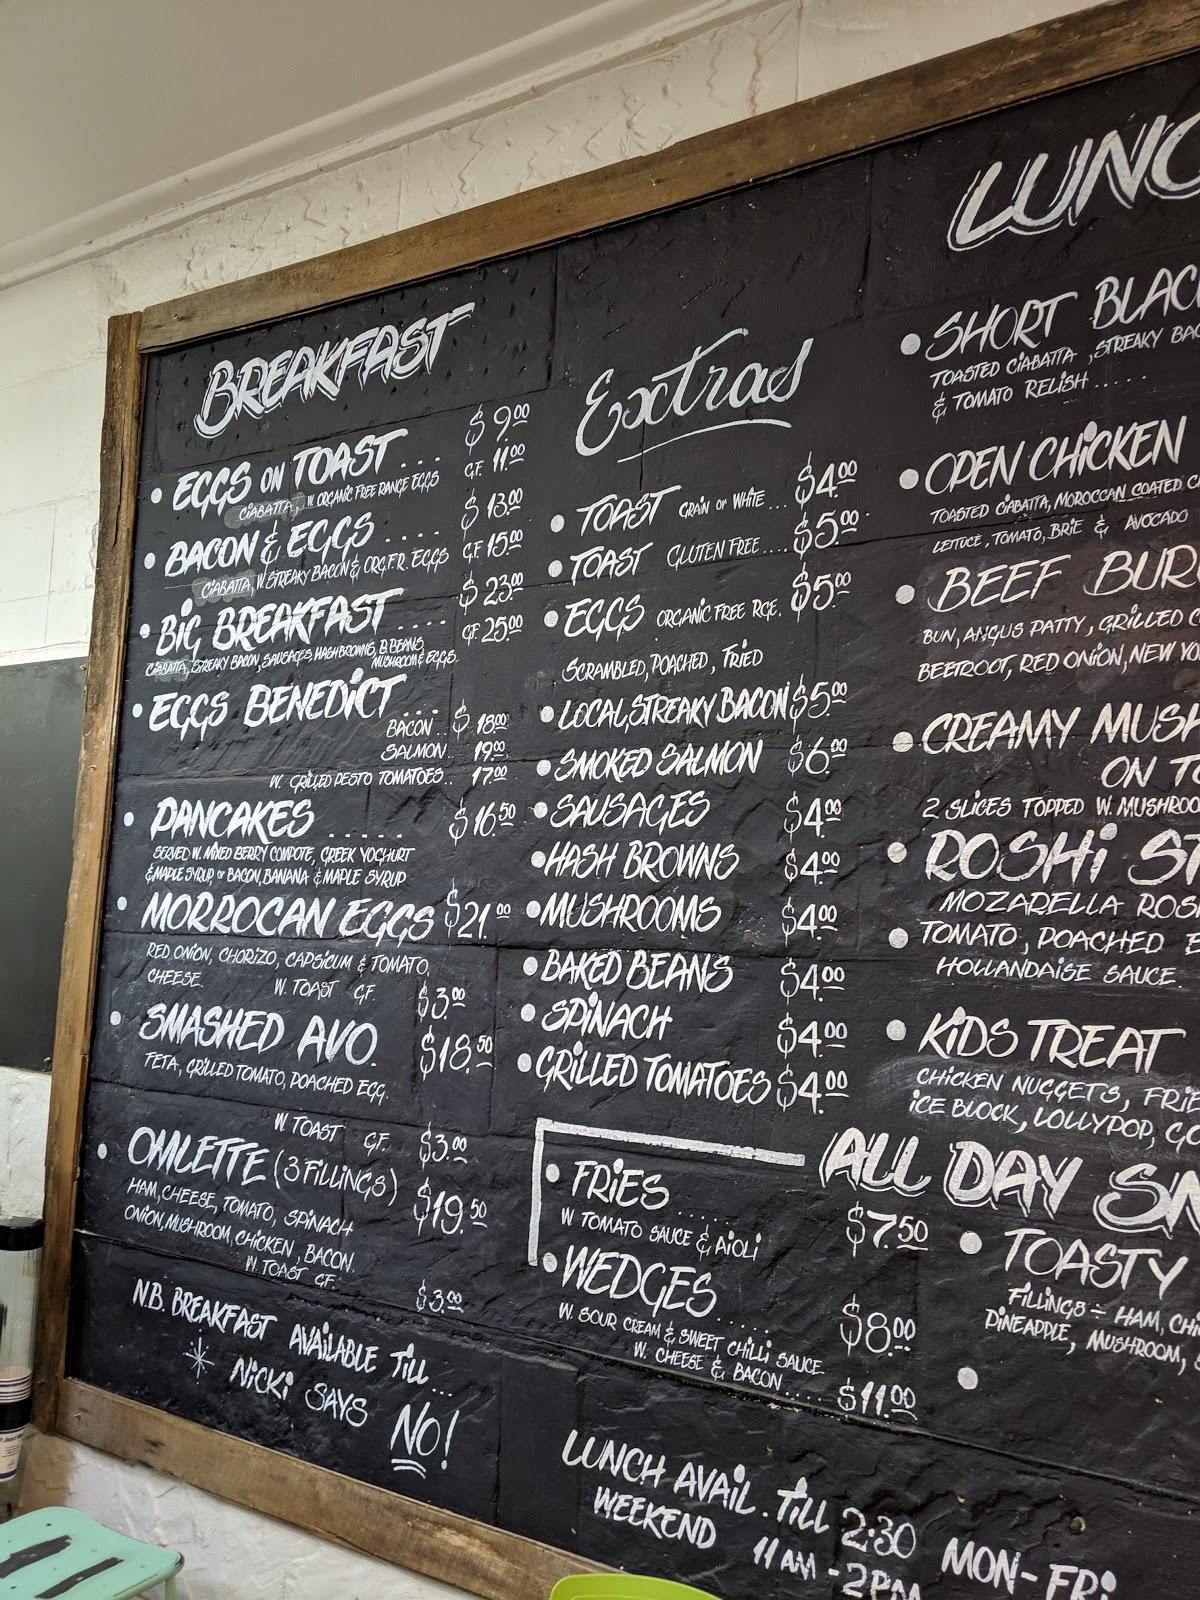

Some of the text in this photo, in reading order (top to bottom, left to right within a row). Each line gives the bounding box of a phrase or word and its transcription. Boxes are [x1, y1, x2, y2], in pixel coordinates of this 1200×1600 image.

[925, 291, 1078, 361] SHORT
[194, 303, 475, 438] BREAKFAST
[575, 328, 814, 456] Extras
[930, 361, 1000, 389] TOASTED
[953, 386, 1014, 411] TOMATO
[172, 428, 408, 520] EGGS ON TOAST
[355, 480, 377, 500] FREE
[378, 474, 408, 497] RANGE
[411, 470, 440, 492] EGGS
[924, 441, 1025, 495] OPEN
[576, 485, 682, 536] TOAST
[930, 477, 1182, 525] TOASTED MOROCCAN COATED
[165, 512, 375, 577] BACON EGGS
[932, 509, 1188, 553] LETTUCE AVOCADO
[266, 569, 311, 590] STREAKY
[311, 559, 350, 579] BACON
[411, 548, 449, 569] EGGS
[570, 542, 654, 586] TOAST
[667, 543, 726, 571] GLUTEN
[729, 538, 760, 562] FREE
[927, 554, 1072, 613] BEEF
[212, 587, 404, 651] BREAKFAST
[564, 595, 645, 642] EGGS
[714, 600, 746, 622] FREE
[963, 621, 1024, 647] ANGUS
[1030, 615, 1087, 637] PATTY
[191, 656, 228, 674] STREAKY
[650, 651, 708, 676] POACHED
[1019, 652, 1060, 674] RED
[148, 691, 229, 742] EGGS
[632, 693, 717, 728] STREAKY
[717, 681, 790, 724] BACON
[387, 718, 433, 738] BACON
[921, 706, 1082, 755] CREAMY
[381, 744, 446, 762] SALMON
[555, 748, 652, 782] SMOKED
[656, 739, 763, 776] SALMON
[1101, 755, 1158, 789] ON
[334, 770, 373, 788] PESTO
[378, 769, 445, 786] TOMATOES
[150, 797, 316, 844] PANCAKES
[550, 790, 710, 835] SAUSAGES
[1022, 797, 1085, 818] TOPPED
[153, 846, 415, 864] SERVED BERRY GREEK YOGHURT
[545, 842, 617, 878] HASH
[623, 840, 739, 882] BROWNS
[153, 867, 406, 889] MAPLE BANANA MAPLE SYRUP
[141, 891, 337, 939] MORROCAN
[338, 897, 434, 947] EGGS
[540, 892, 722, 933] MUSHROOMS
[939, 890, 1124, 916] MOZARELLA
[146, 942, 170, 959] RED
[1037, 926, 1165, 955] POACHED
[291, 979, 339, 999] TOAST
[541, 949, 622, 990] BAKED
[626, 950, 734, 993] BEANS
[1103, 964, 1177, 986] SAUCE
[138, 1003, 285, 1055] SMASHED
[1027, 1018, 1186, 1074] TREAT
[290, 1072, 353, 1095] POACHED
[643, 1054, 772, 1105] TOMATOES
[293, 1117, 345, 1143] TOAST
[127, 1127, 269, 1186] OMLETTE
[818, 1127, 1084, 1219] ALL DAY
[581, 1212, 693, 1247] TOMATO SAUCE
[562, 1244, 718, 1318] WEDGES
[1003, 1227, 1189, 1299] TOASTY
[172, 1287, 278, 1339] BREAKFAST
[578, 1307, 825, 1376] SOUR CREAM SWEET SAUCE
[656, 1347, 705, 1370] CHEESE
[733, 1364, 783, 1391] BACON
[304, 1384, 368, 1427] SAYS
[390, 1402, 459, 1470] NO!
[562, 1430, 666, 1486] LUNCH
[593, 1486, 717, 1550] WEEKEND
